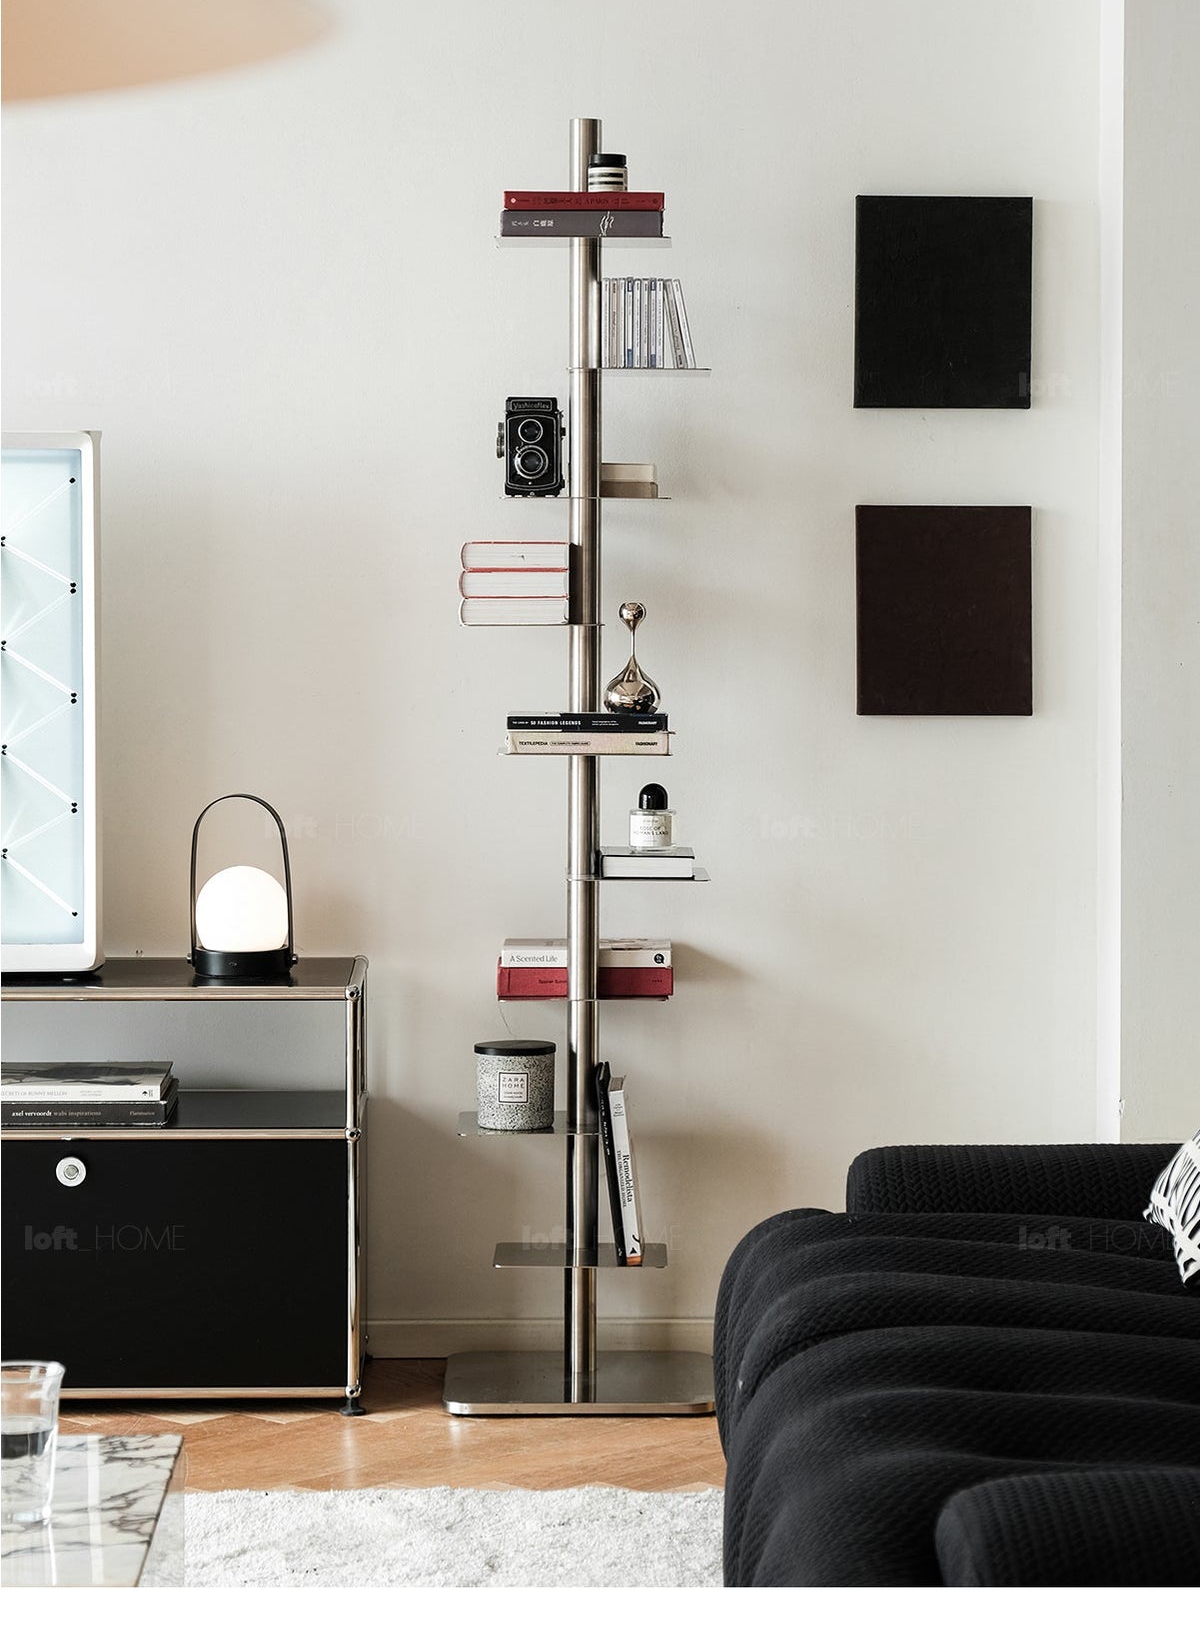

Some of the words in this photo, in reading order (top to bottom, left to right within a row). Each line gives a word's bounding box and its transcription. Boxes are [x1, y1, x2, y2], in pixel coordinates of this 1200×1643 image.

[516, 954, 545, 962] Scented
[68, 1110, 102, 1118] inspirations
[617, 1161, 626, 1193] ORGANIZED
[622, 1154, 633, 1203] Remodelista
